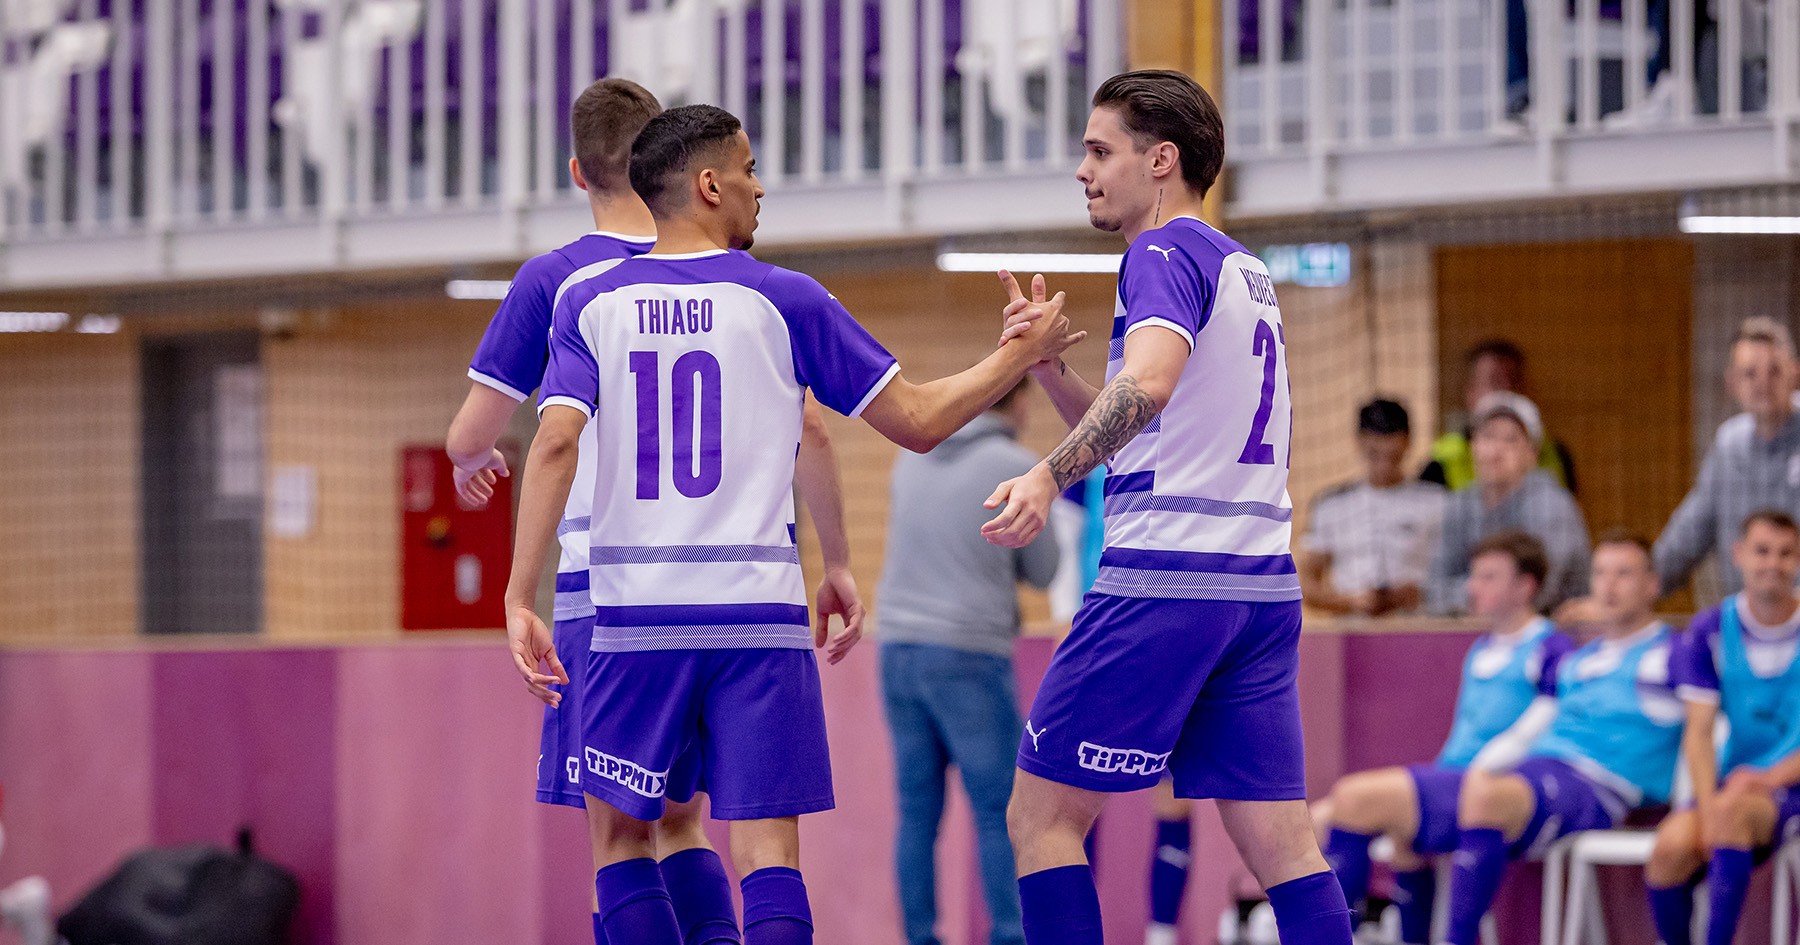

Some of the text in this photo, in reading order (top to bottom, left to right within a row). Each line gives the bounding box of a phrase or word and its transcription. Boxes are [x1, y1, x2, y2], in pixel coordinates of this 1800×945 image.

[635, 298, 713, 334] THIAGO
[629, 350, 722, 499] 10
[1077, 741, 1170, 775] TiPPM
